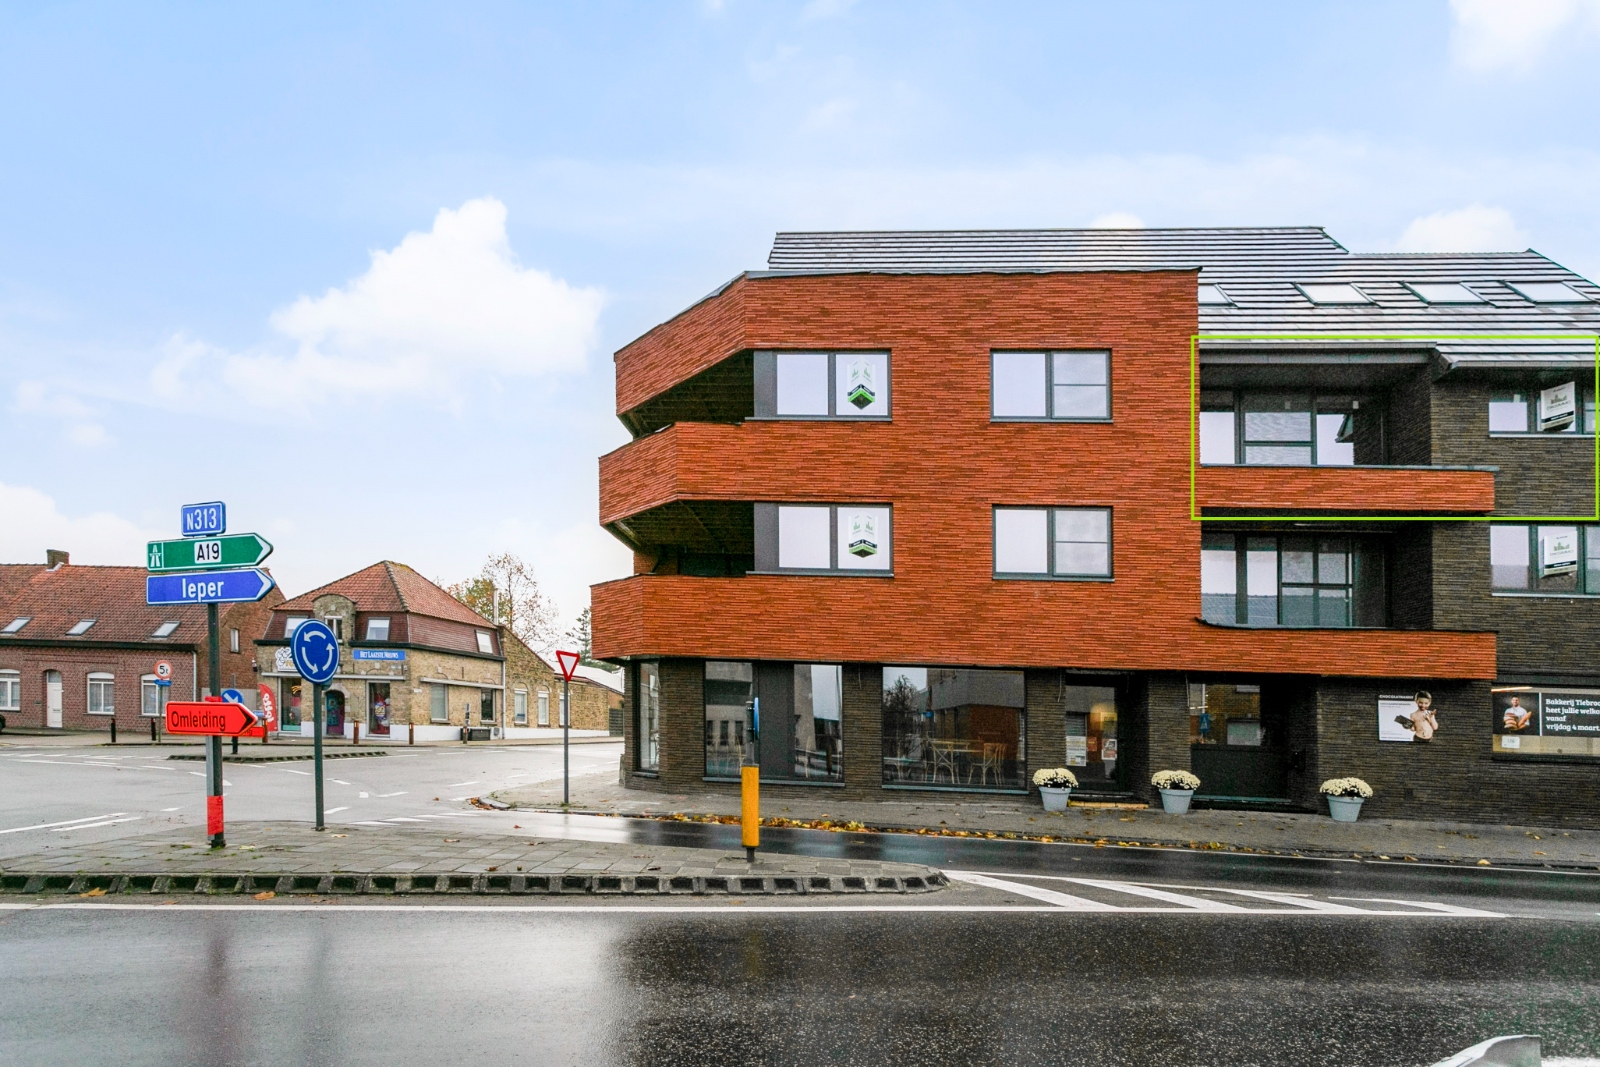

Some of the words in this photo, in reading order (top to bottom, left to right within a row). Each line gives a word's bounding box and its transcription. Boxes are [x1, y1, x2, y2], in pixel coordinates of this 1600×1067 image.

[186, 507, 217, 531] N313
[196, 542, 220, 561] A19
[182, 578, 225, 603] Ieper
[1545, 698, 1575, 707] Bakkerij
[1545, 706, 1562, 714] heet
[1561, 706, 1580, 715] jullie
[171, 710, 226, 732] Omleiding
[1546, 723, 1572, 732] vrijdag
